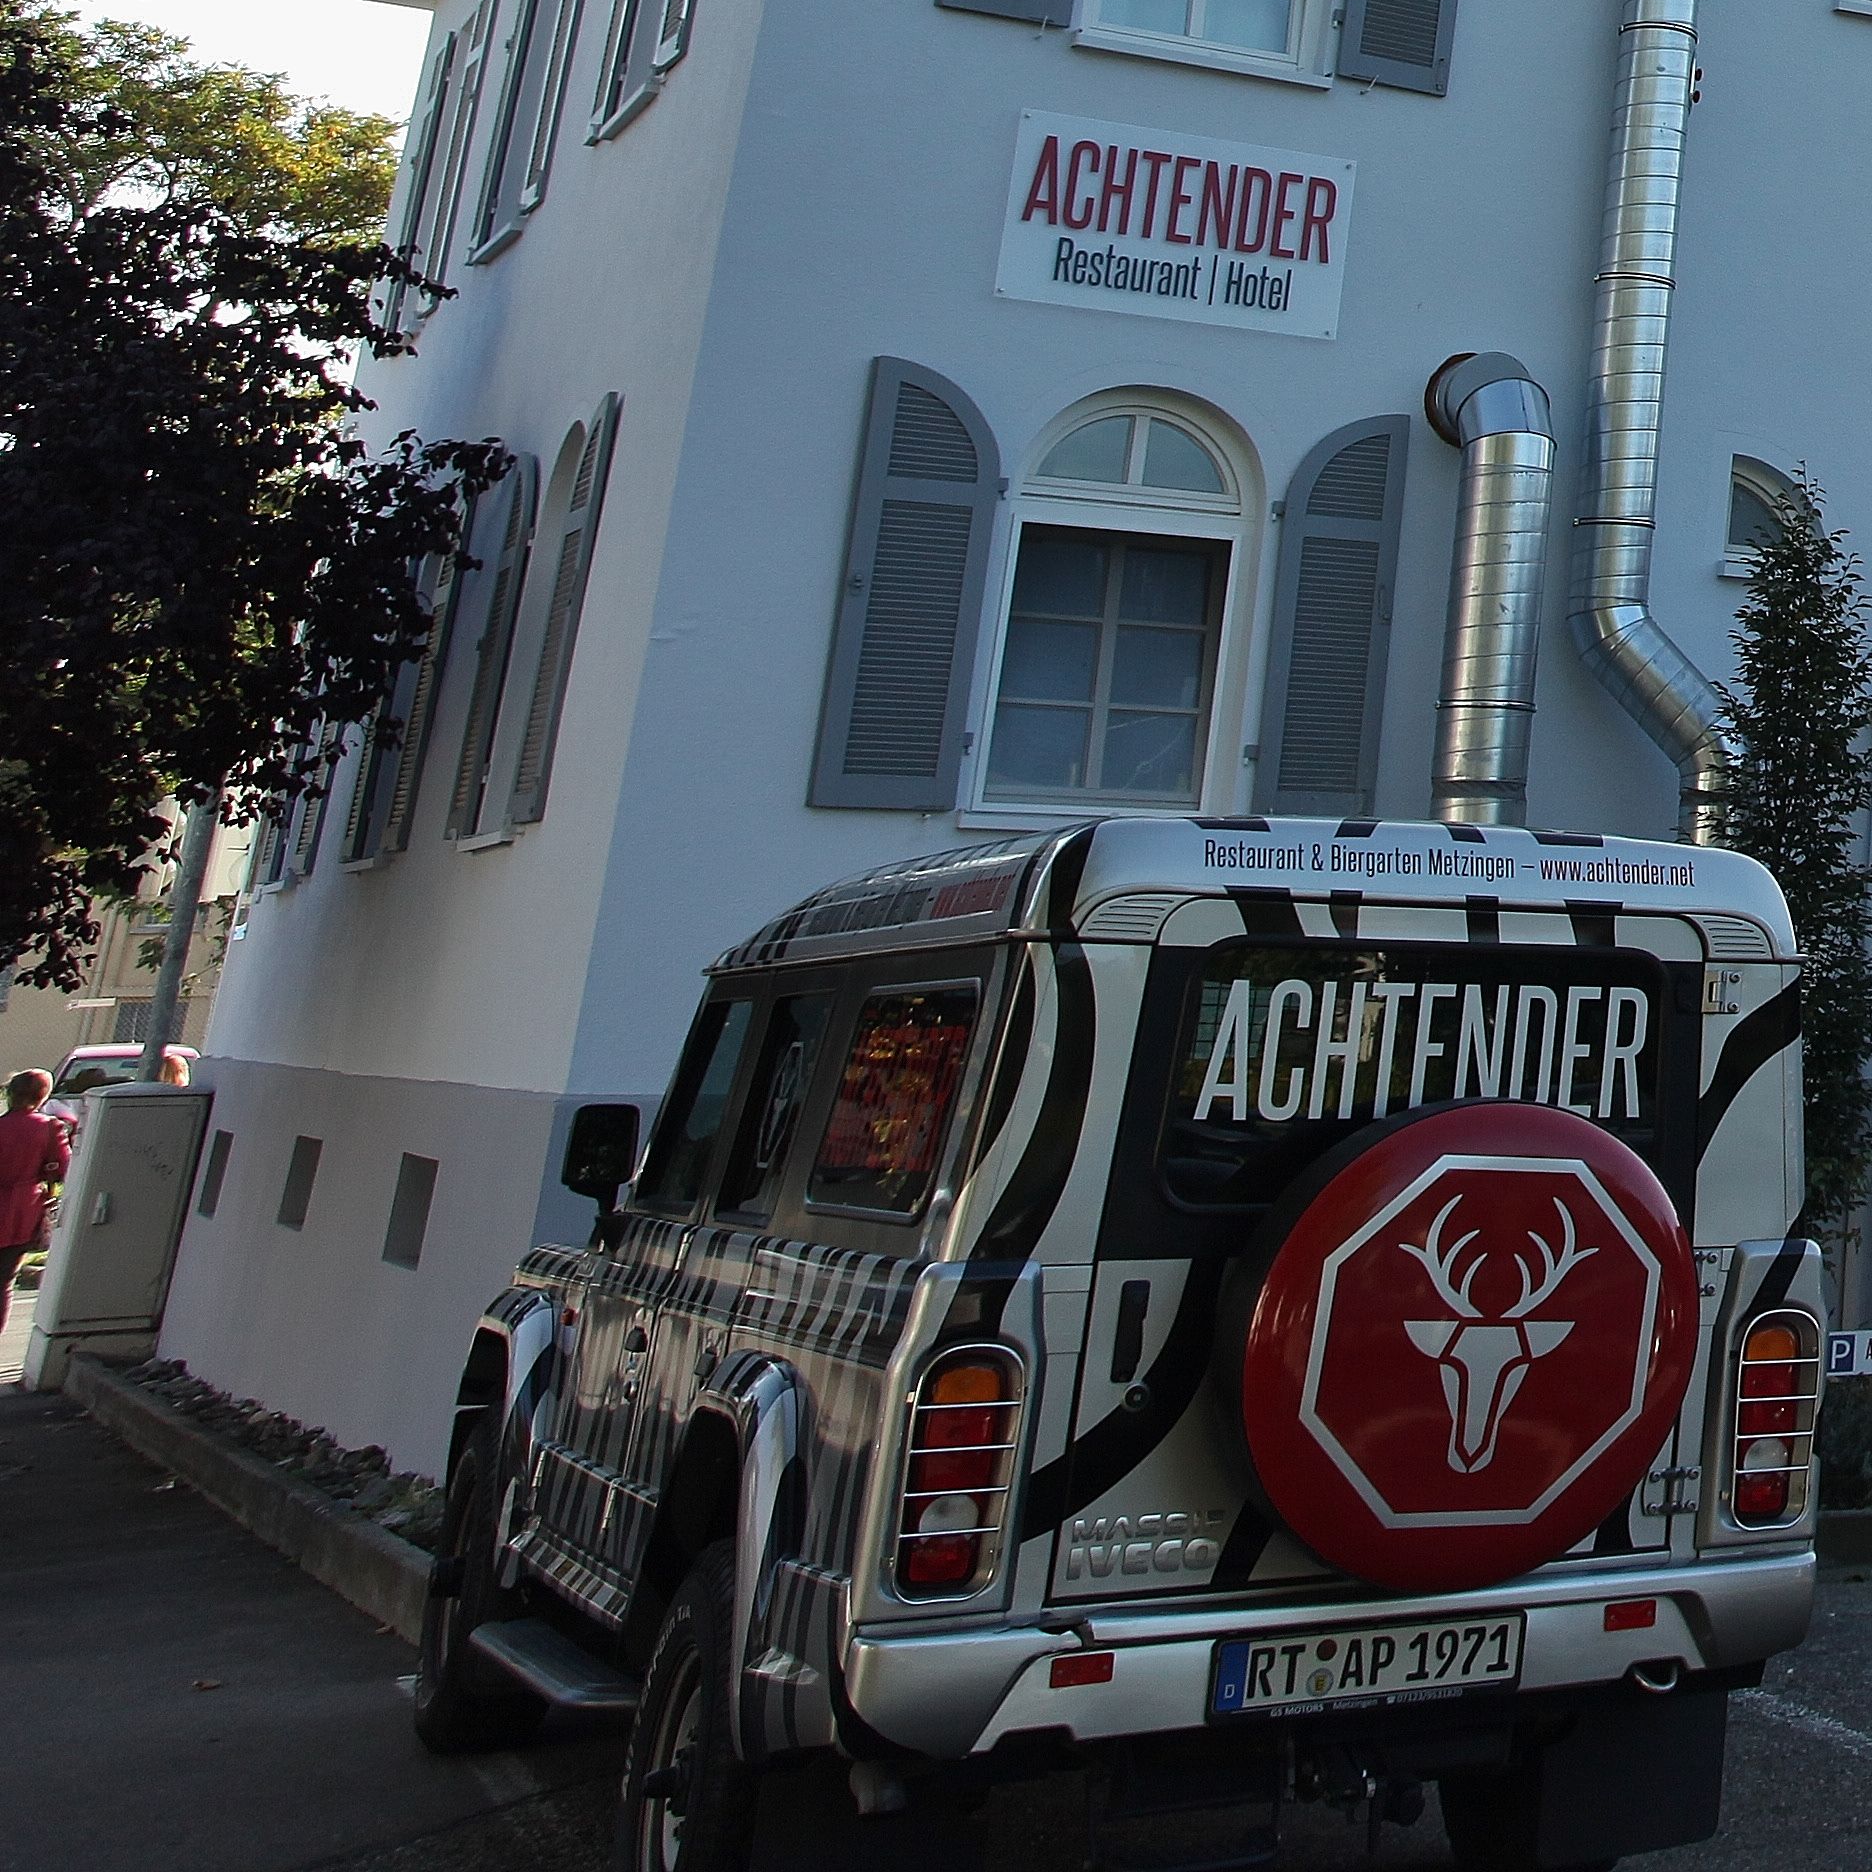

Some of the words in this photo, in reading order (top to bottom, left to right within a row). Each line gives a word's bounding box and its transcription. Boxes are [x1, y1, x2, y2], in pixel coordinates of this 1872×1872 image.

[1021, 135, 1338, 264] ACHTENDER
[1053, 237, 1202, 300] Restaurant
[1224, 260, 1292, 312] Hotel
[1204, 839, 1304, 871] Restaurant
[1311, 844, 1325, 872] &
[1330, 845, 1422, 878] Biergarten
[1428, 848, 1515, 883] Metzingen
[1540, 858, 1695, 888] www.achtender.net
[1194, 979, 1649, 1120] ACHTENDER
[1830, 1339, 1851, 1370] P
[1071, 1510, 1227, 1543] MASSIF
[1065, 1538, 1220, 1581] IVECO
[1223, 1684, 1236, 1699] D
[1246, 1643, 1307, 1699] RT
[1338, 1636, 1396, 1689] AP
[1405, 1624, 1511, 1682] 1971
[1284, 1702, 1325, 1715] MOTORS
